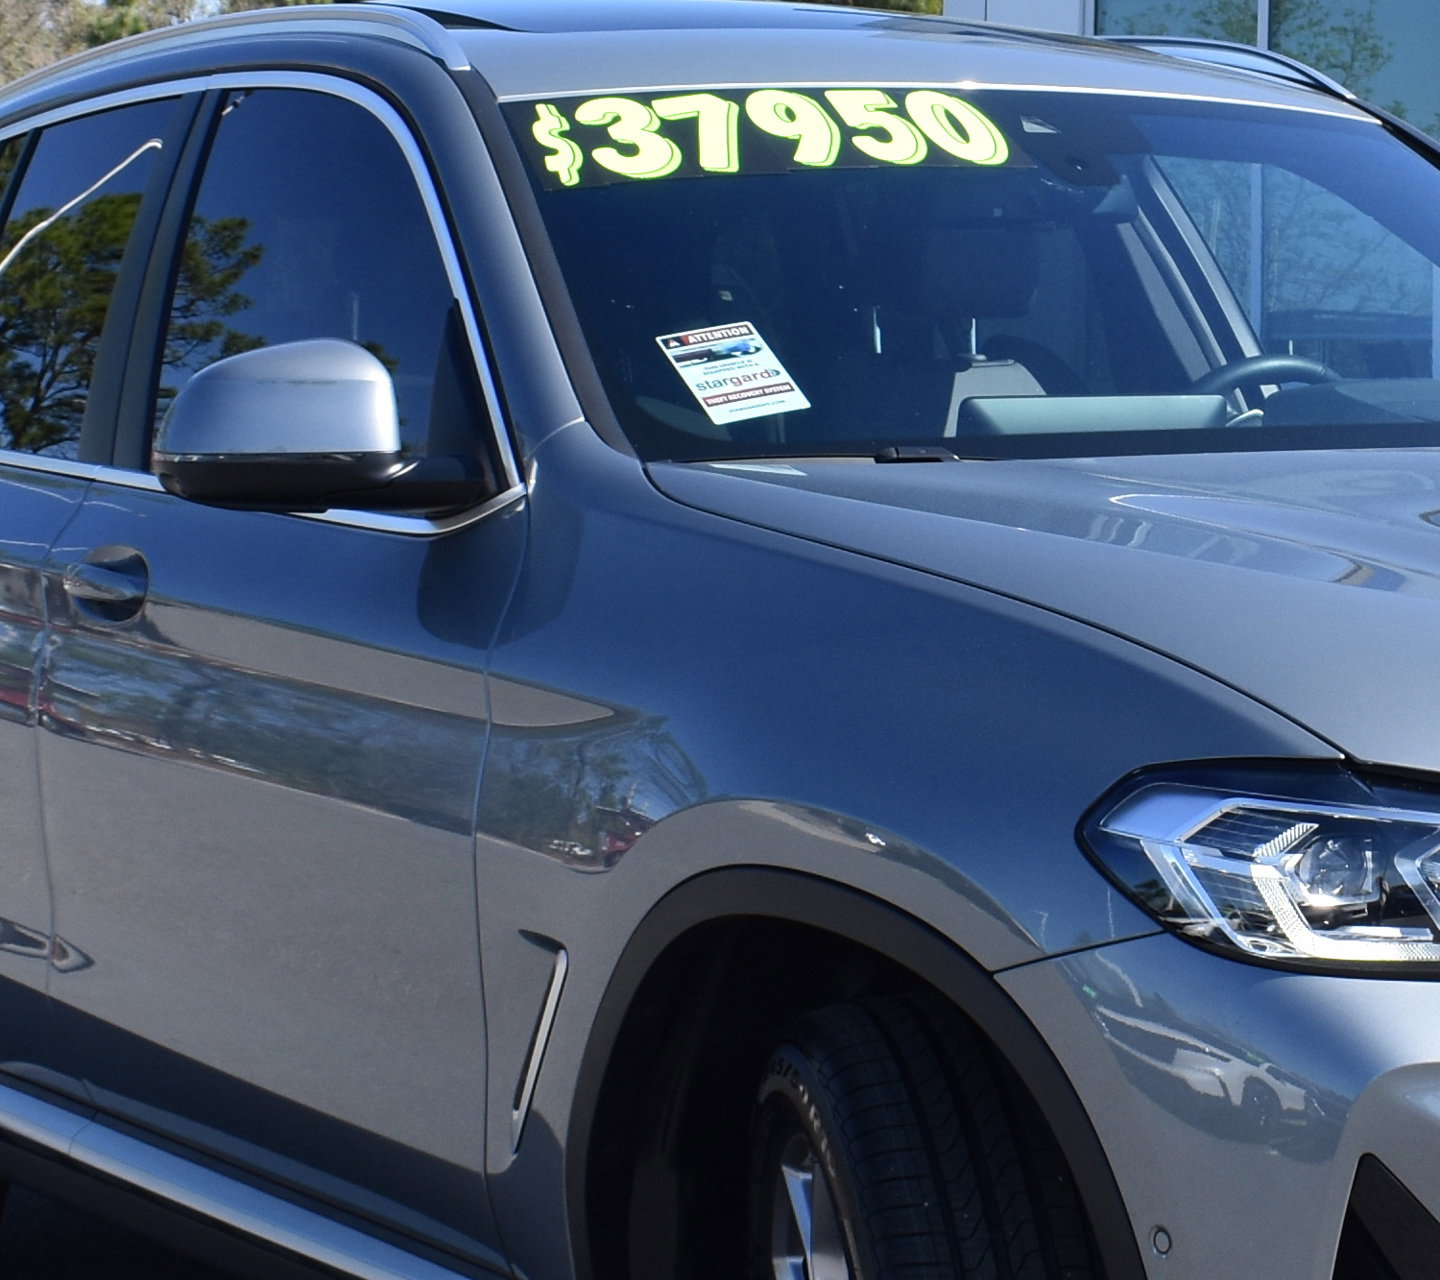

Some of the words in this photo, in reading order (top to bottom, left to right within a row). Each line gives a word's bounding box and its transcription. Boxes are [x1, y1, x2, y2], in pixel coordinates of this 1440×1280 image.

[532, 89, 1009, 187] $37950
[687, 326, 750, 343] ATTENTION
[696, 368, 771, 391] stargard
